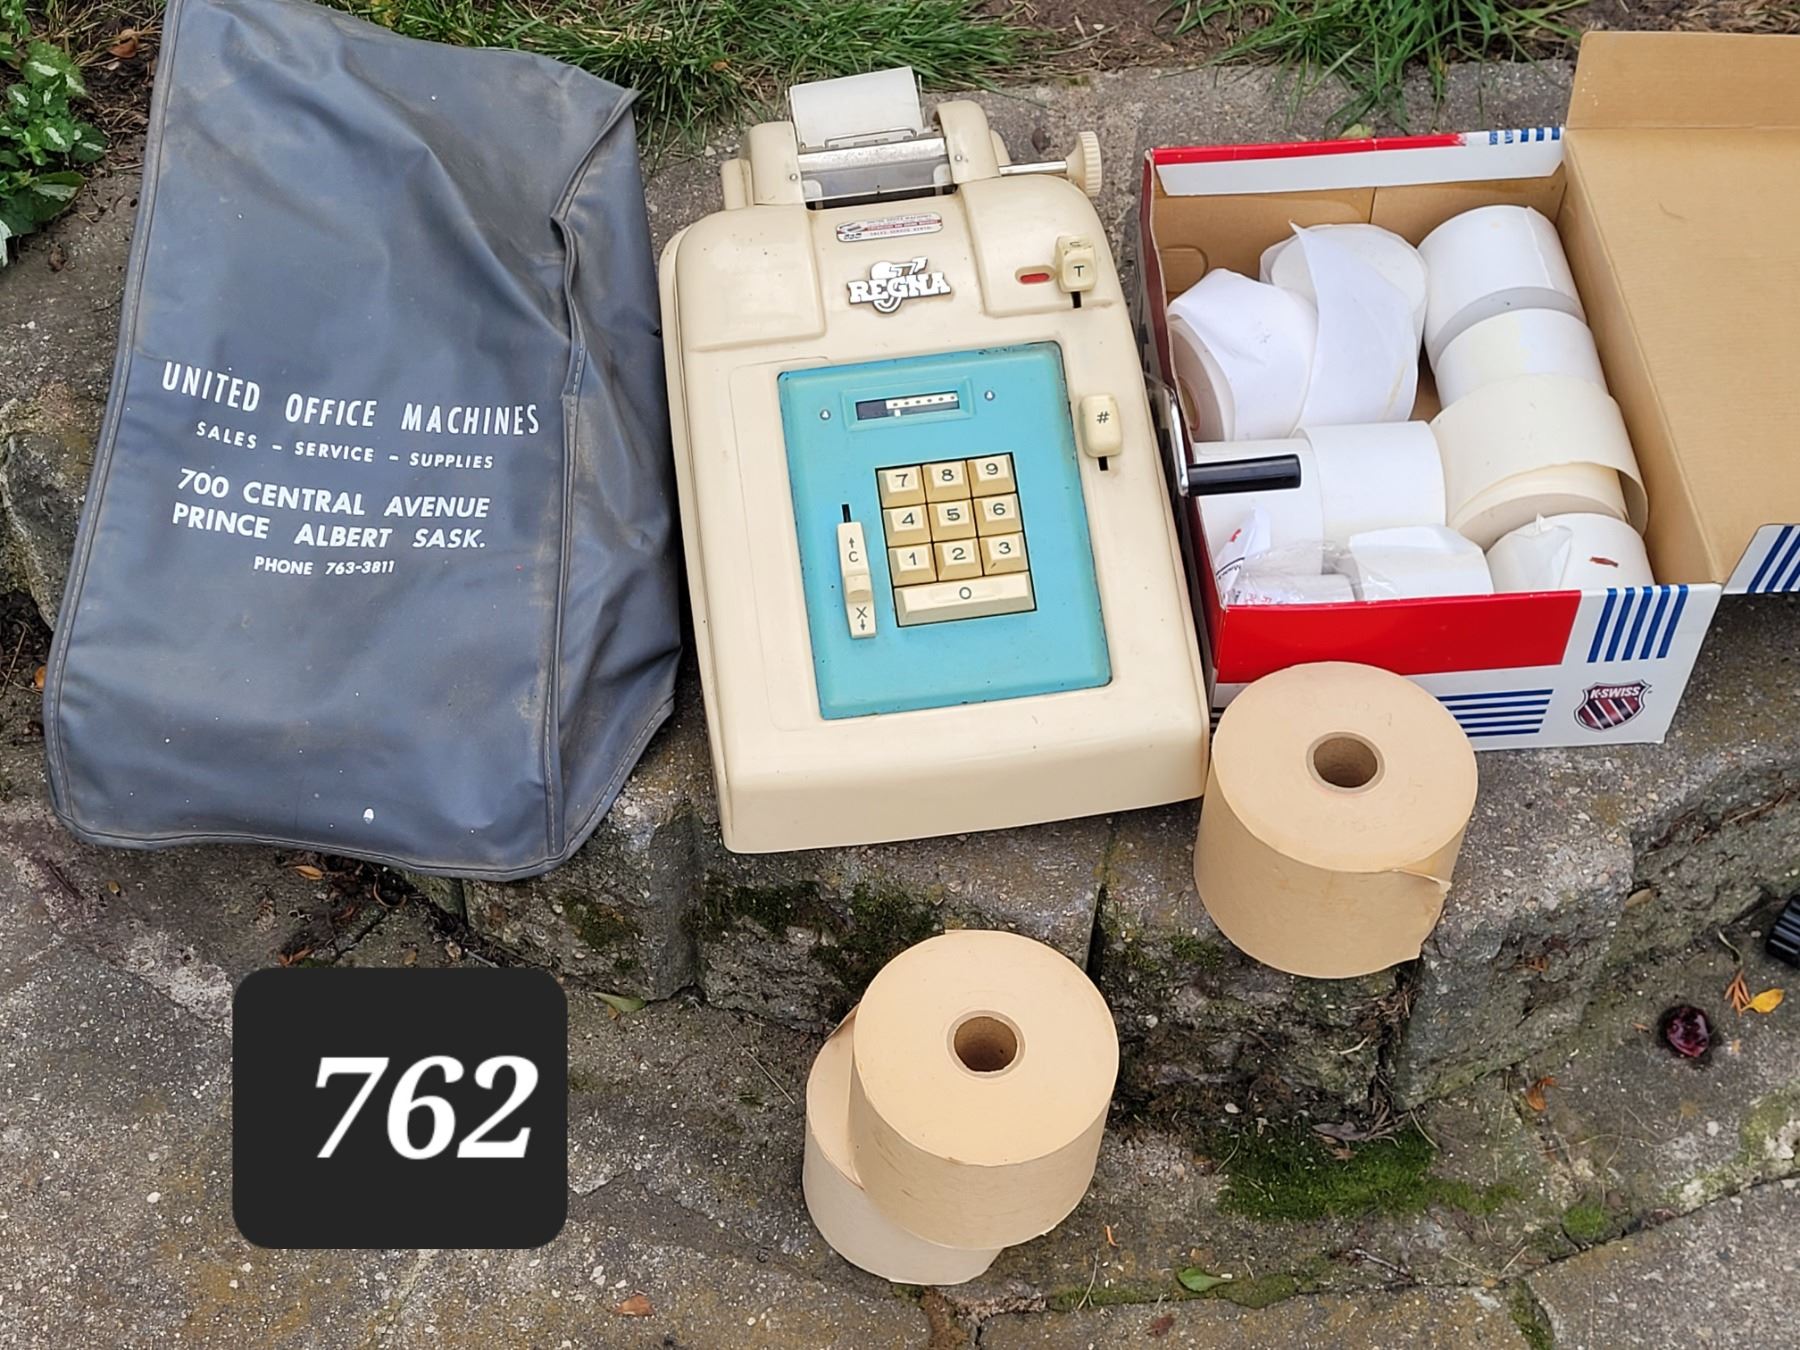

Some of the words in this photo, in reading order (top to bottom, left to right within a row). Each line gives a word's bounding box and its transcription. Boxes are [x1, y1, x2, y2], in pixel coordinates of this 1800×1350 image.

[1073, 265, 1085, 277] T
[847, 271, 951, 304] REGNA
[162, 361, 260, 412] UNITED
[285, 393, 378, 428] OFFICE
[401, 403, 540, 436] MACHINES
[1096, 411, 1110, 424] #
[196, 421, 257, 449] SALES
[295, 441, 374, 463] SERVICE
[409, 452, 494, 469] SUPPLIES
[896, 474, 908, 487] 7
[942, 469, 954, 482] 8
[986, 463, 998, 476] 9
[177, 468, 229, 498] 700
[243, 481, 365, 516] CENTRAL
[384, 496, 490, 519] AVENUE
[172, 502, 270, 540] PRINCE
[294, 523, 393, 549] ALBERT
[413, 528, 487, 549] SASK.
[902, 512, 915, 525] 4
[947, 508, 960, 521] 5
[993, 503, 1006, 515] 6
[848, 551, 859, 563] C
[909, 552, 917, 566] 1
[953, 548, 966, 560] 2
[999, 542, 1011, 554] 3
[254, 556, 313, 576] PHONE
[325, 560, 394, 576] 763-3811
[856, 606, 867, 619] X
[1590, 686, 1640, 699] K-SWISS
